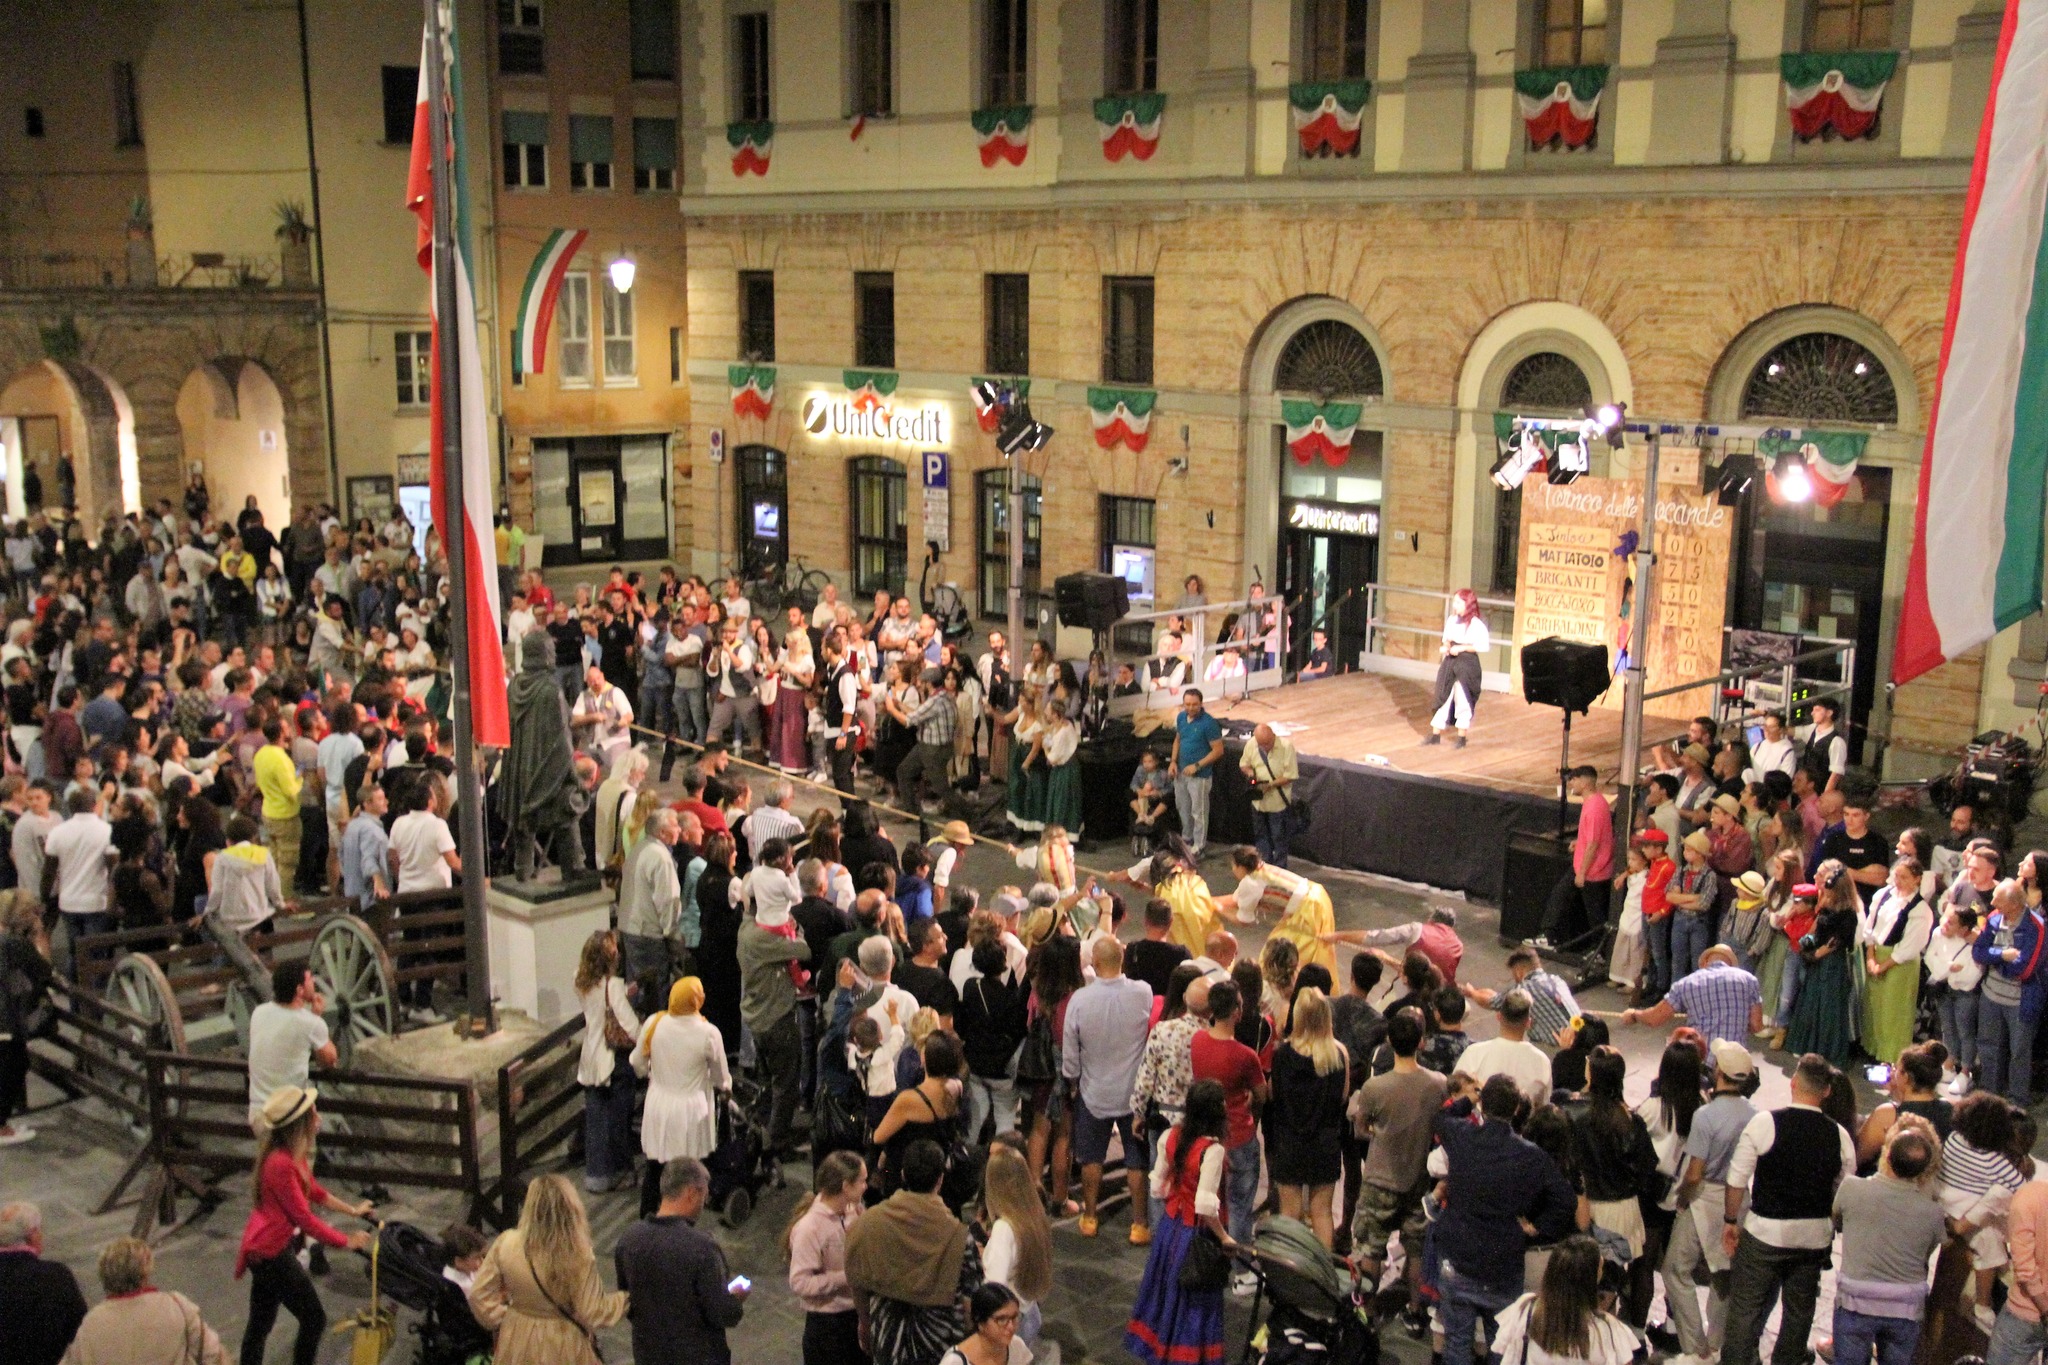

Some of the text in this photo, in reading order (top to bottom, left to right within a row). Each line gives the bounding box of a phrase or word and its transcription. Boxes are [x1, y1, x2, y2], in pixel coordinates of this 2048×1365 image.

[832, 402, 943, 443] UniCredit
[926, 454, 942, 485] P
[1604, 492, 1639, 518] delle
[1655, 496, 1724, 529] ocande
[1539, 548, 1604, 568] MATTATOIO
[1535, 571, 1597, 590] BRIGANTI
[1669, 562, 1678, 577] 7
[1526, 615, 1597, 637] GARIBALDINI
